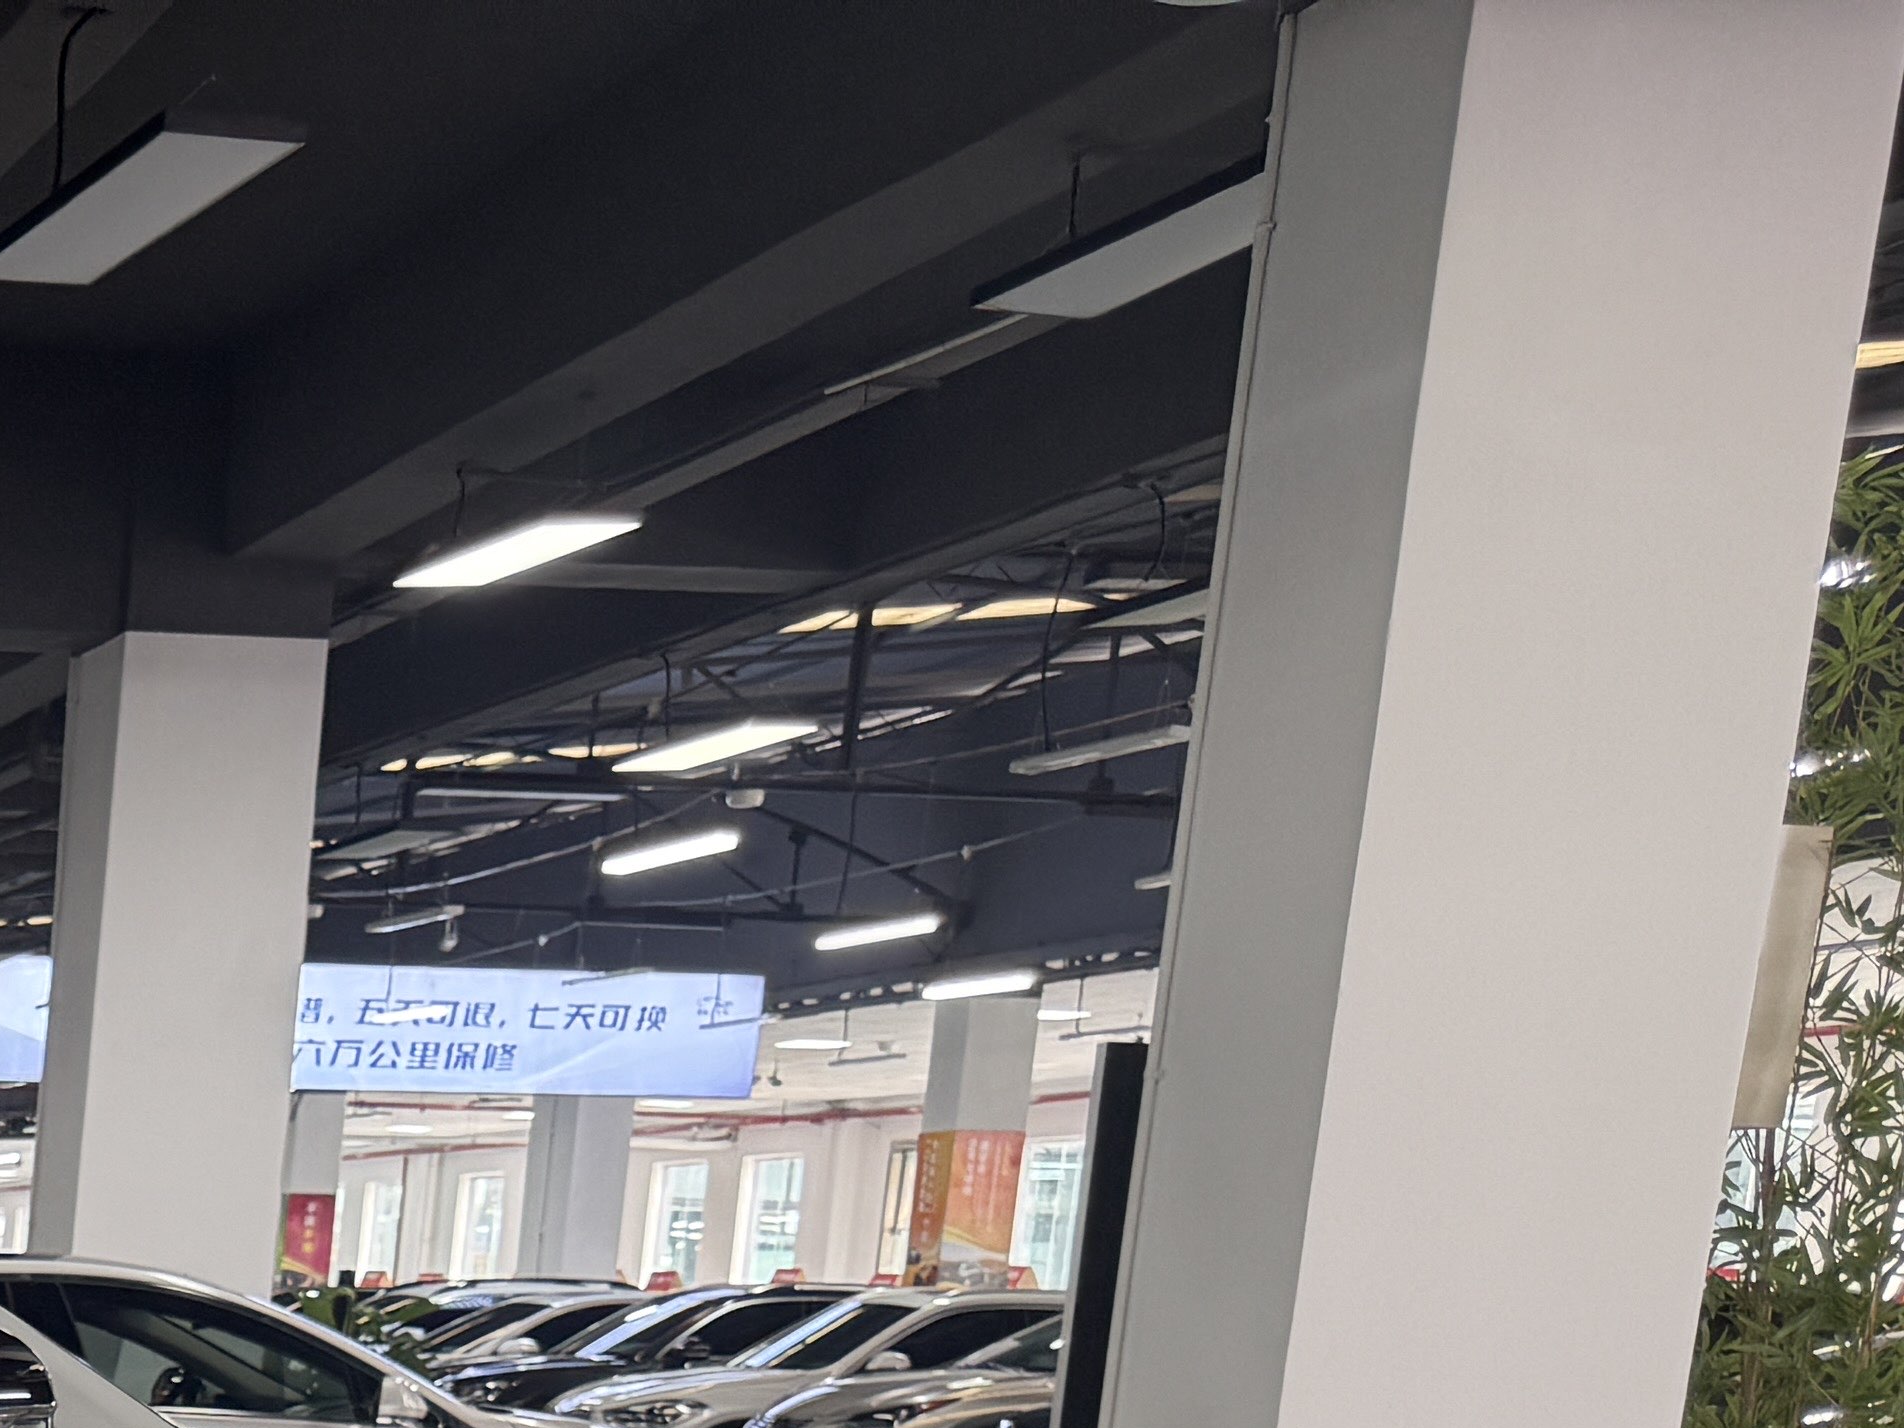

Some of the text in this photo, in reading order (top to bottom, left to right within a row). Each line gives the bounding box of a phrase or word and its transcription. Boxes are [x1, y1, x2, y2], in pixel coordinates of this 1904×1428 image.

[292, 1038, 518, 1073] 六万公里保修
